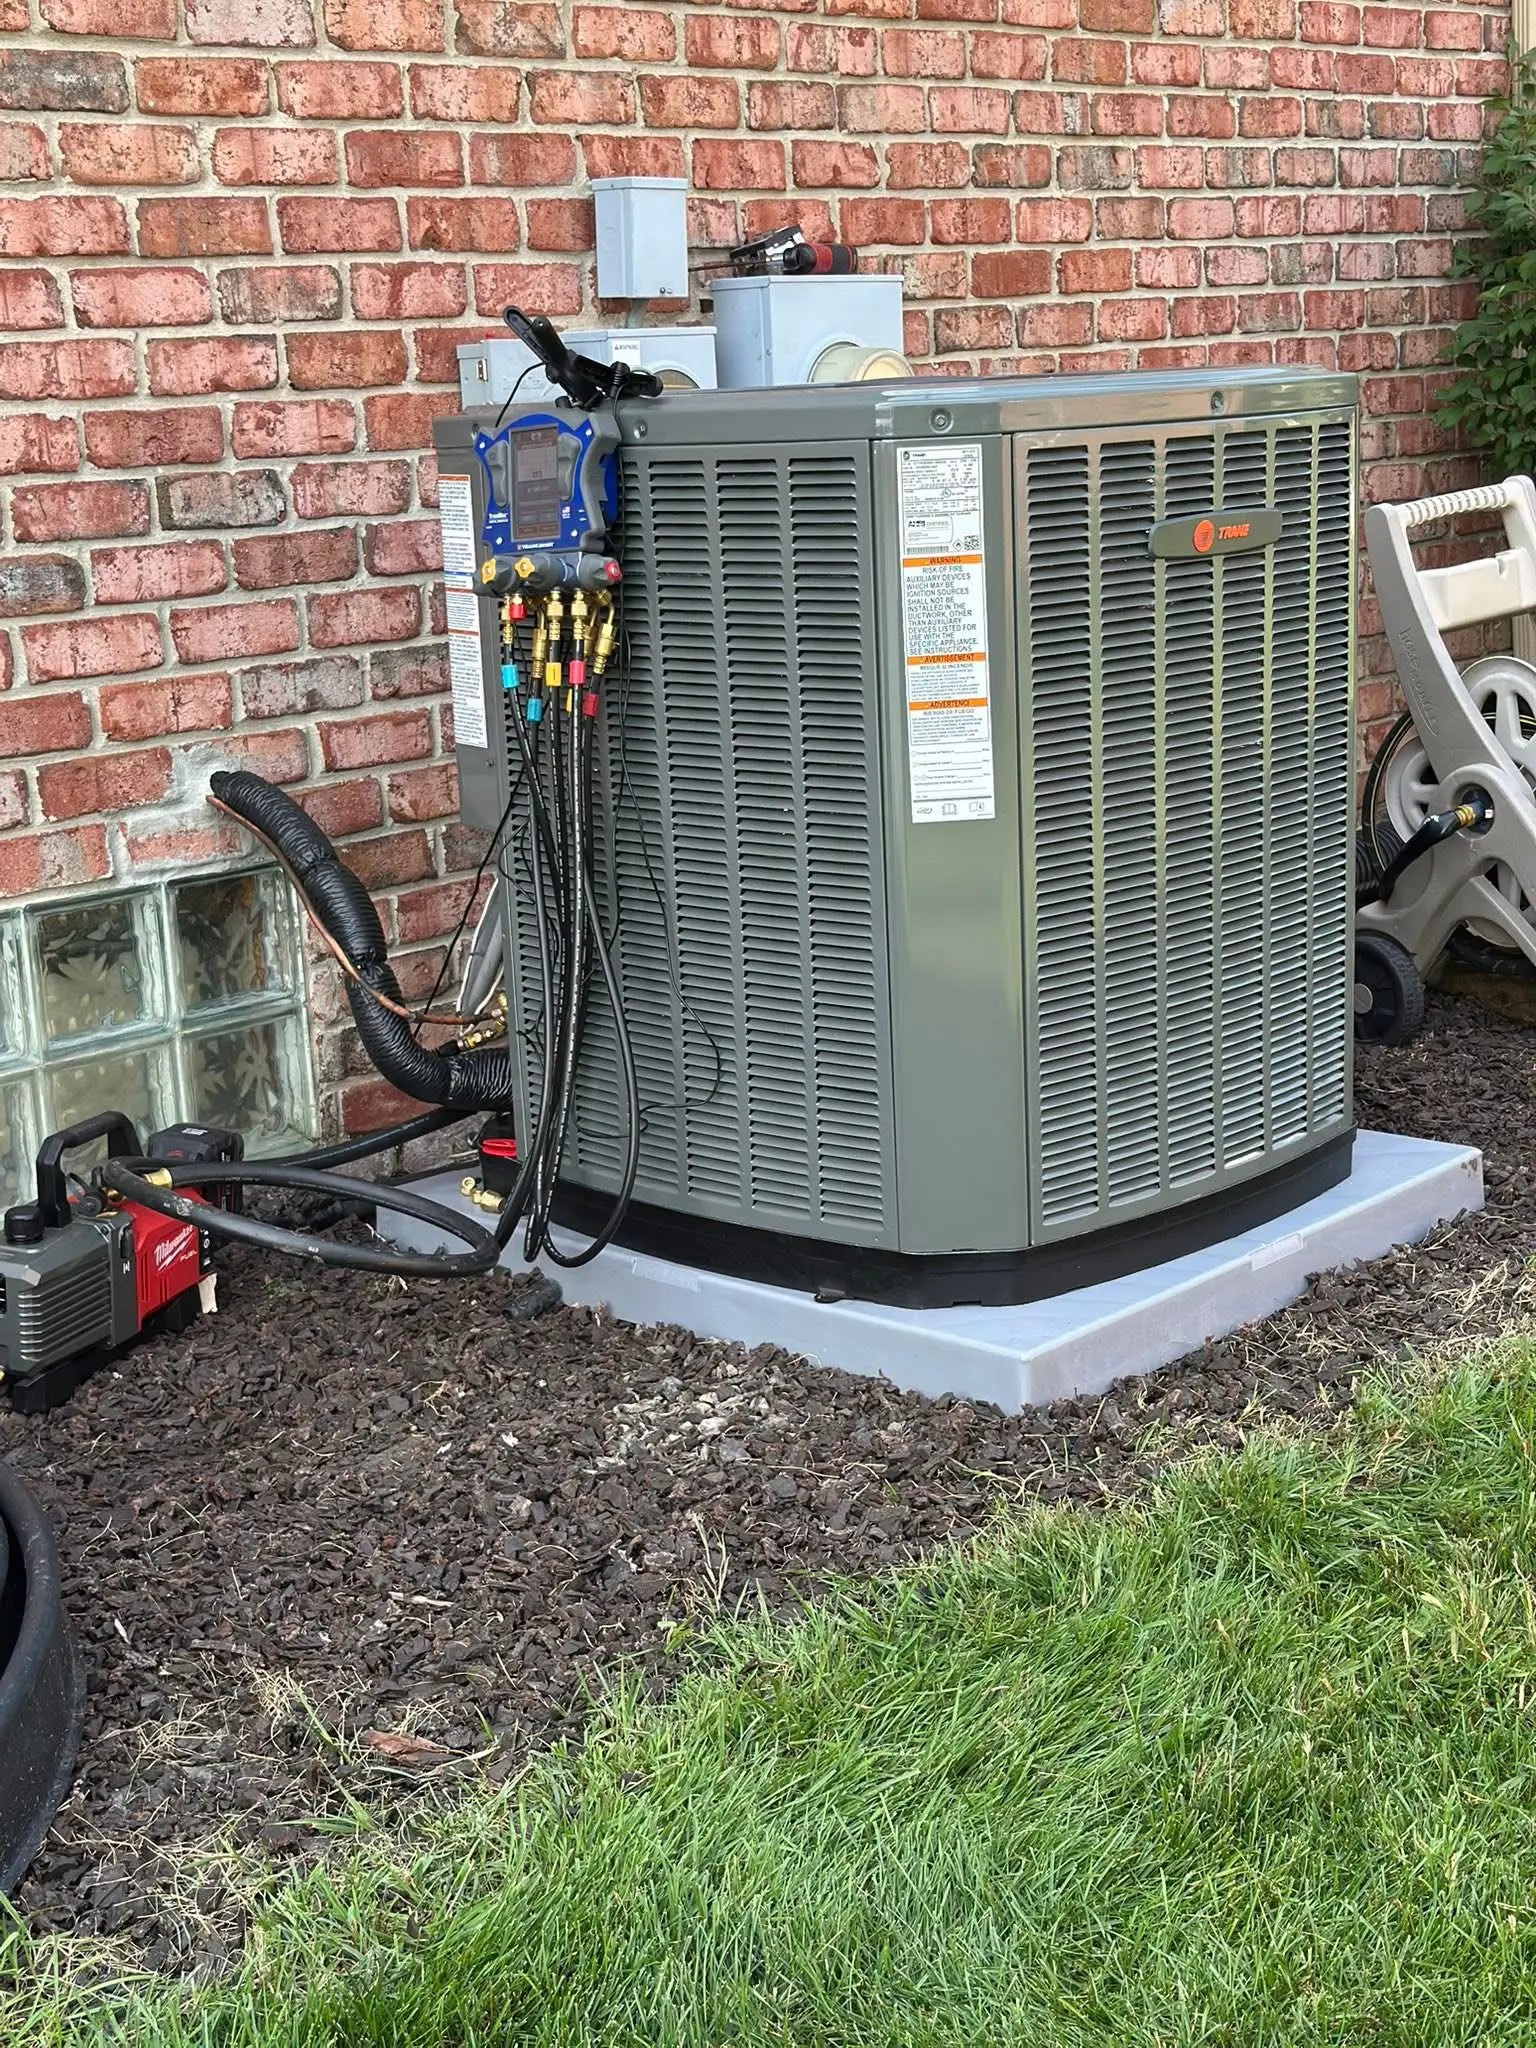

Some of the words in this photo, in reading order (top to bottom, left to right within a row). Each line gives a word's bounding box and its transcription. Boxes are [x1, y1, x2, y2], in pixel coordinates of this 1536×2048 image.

[1218, 523, 1250, 540] TRANE
[930, 556, 962, 565] WARNING
[906, 574, 940, 583] AUXILIARY
[942, 572, 971, 581] DEVICES
[906, 590, 936, 598] IGNITION
[937, 588, 969, 596] SOURCES
[908, 604, 943, 612] INSTALLED
[928, 618, 962, 626] AUXILIARY
[908, 626, 937, 634] DEVICES
[909, 640, 940, 648] SPECIFIC
[924, 645, 972, 654] INSTRUCTIONS
[924, 654, 974, 663] AVERTISSEMENT
